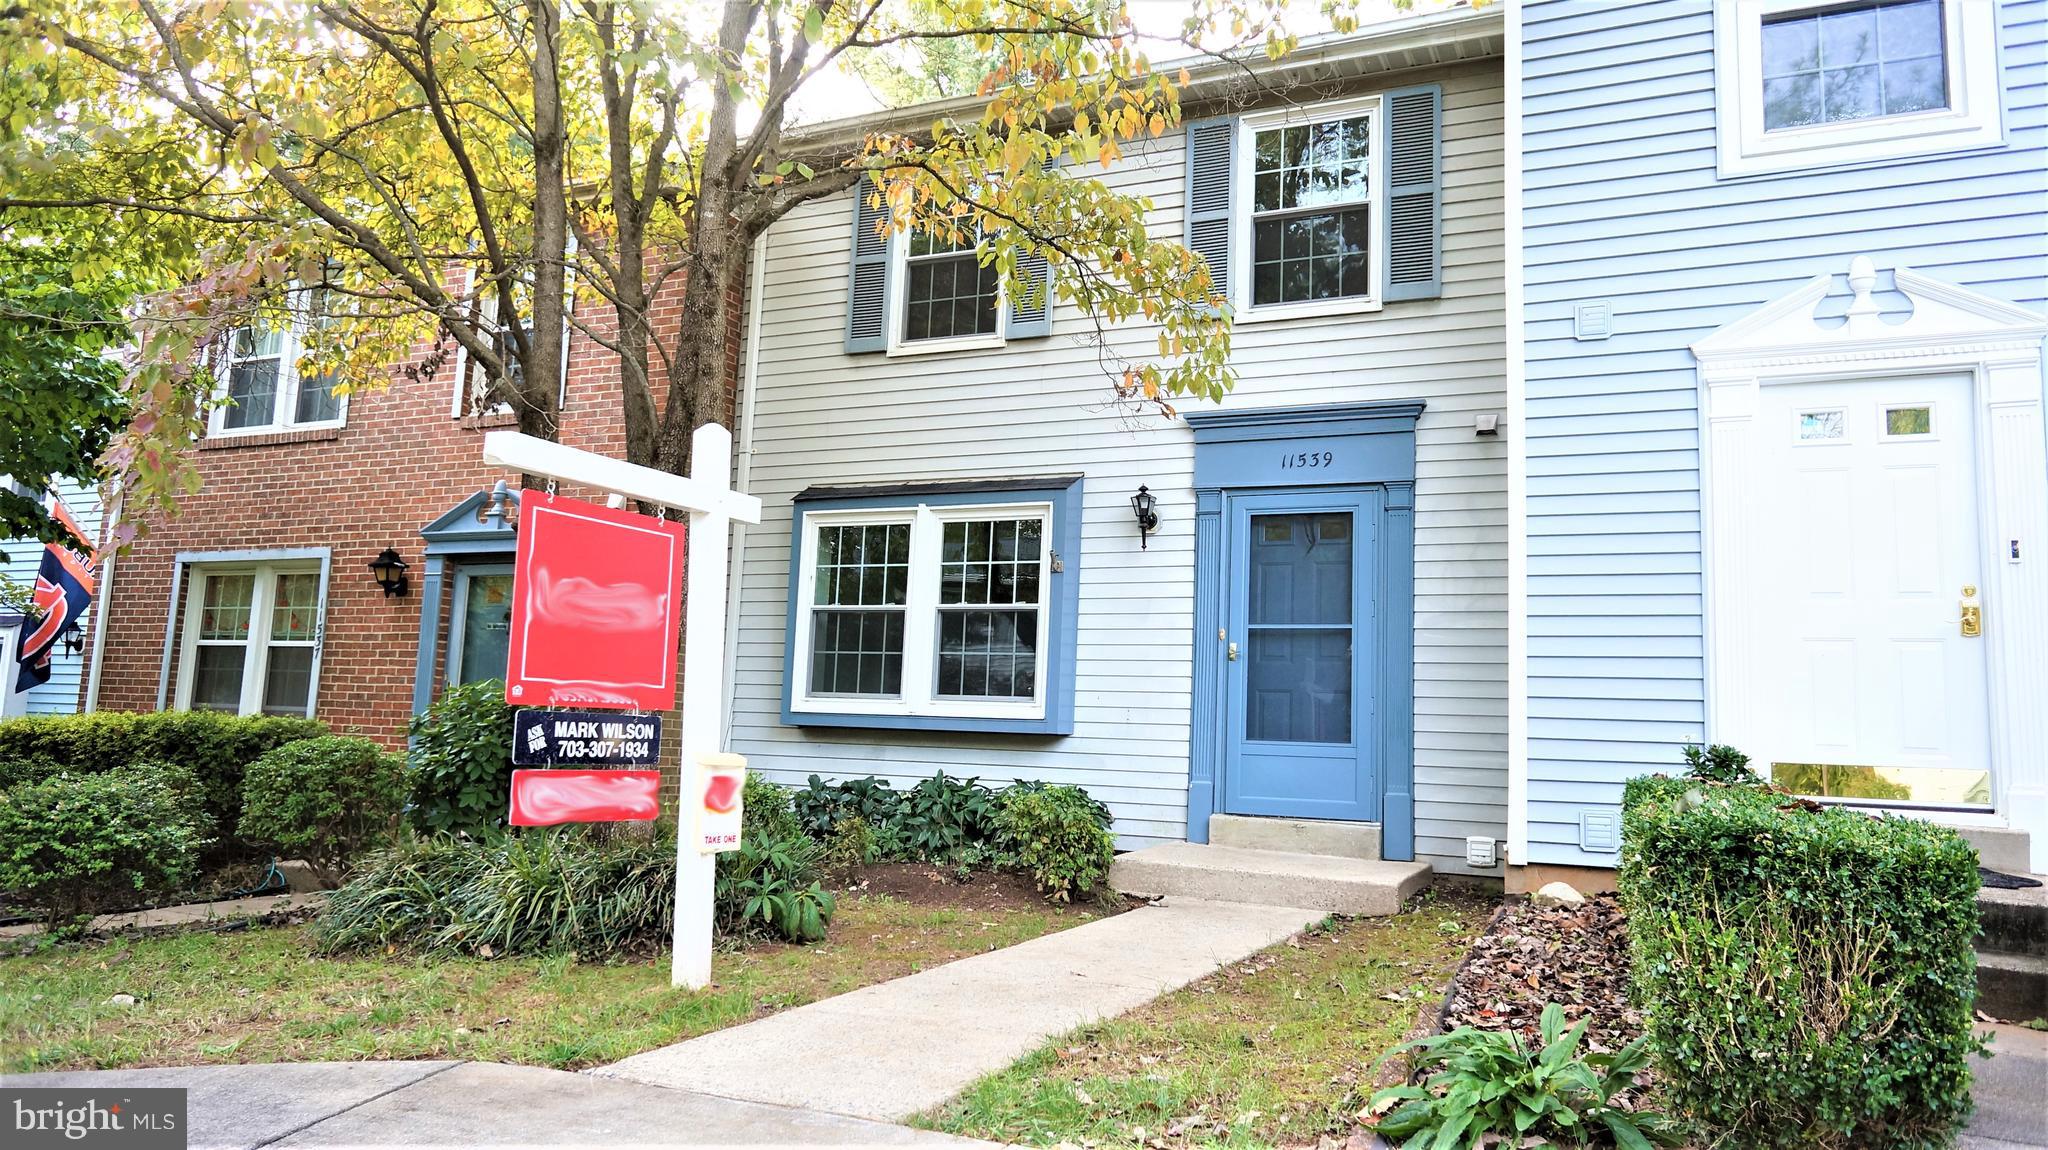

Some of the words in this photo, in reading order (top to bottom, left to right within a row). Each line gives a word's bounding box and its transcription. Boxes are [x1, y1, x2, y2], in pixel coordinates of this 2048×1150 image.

[1281, 451, 1333, 469] 11539
[314, 597, 324, 660] 11537
[527, 724, 544, 740] ASK
[554, 720, 599, 739] MARK
[602, 722, 655, 741] WILSON
[528, 736, 547, 753] FOR
[557, 740, 649, 758] 703-307-1934
[704, 835, 721, 845] TAKE
[723, 834, 737, 844] ONE
